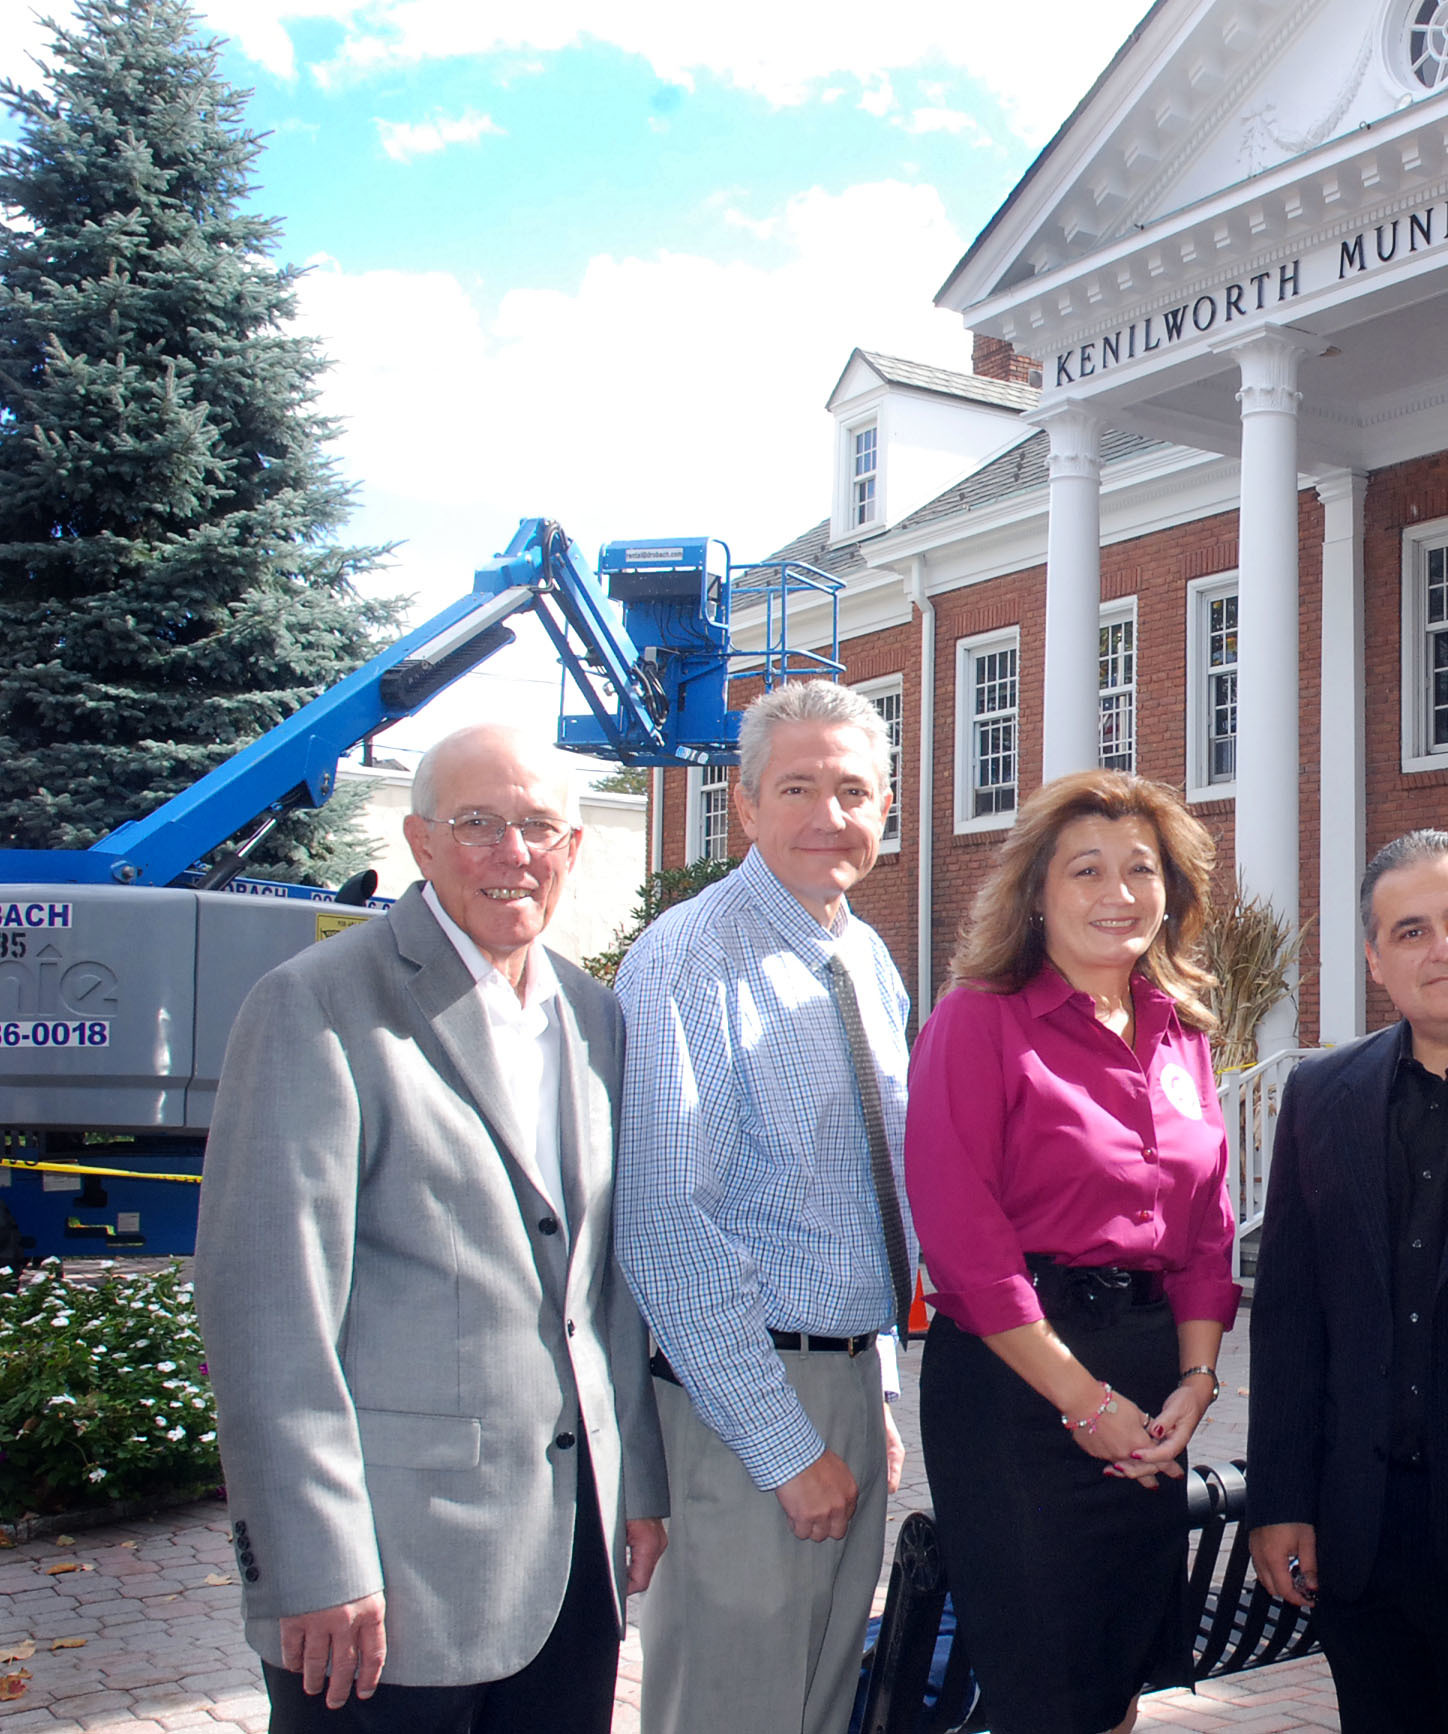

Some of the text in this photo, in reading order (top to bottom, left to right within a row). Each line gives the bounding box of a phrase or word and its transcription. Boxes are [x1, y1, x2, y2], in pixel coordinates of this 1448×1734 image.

[1056, 259, 1299, 387] KENILWORTH
[0, 903, 70, 927] ACH
[0, 1022, 107, 1046] 6-0018
